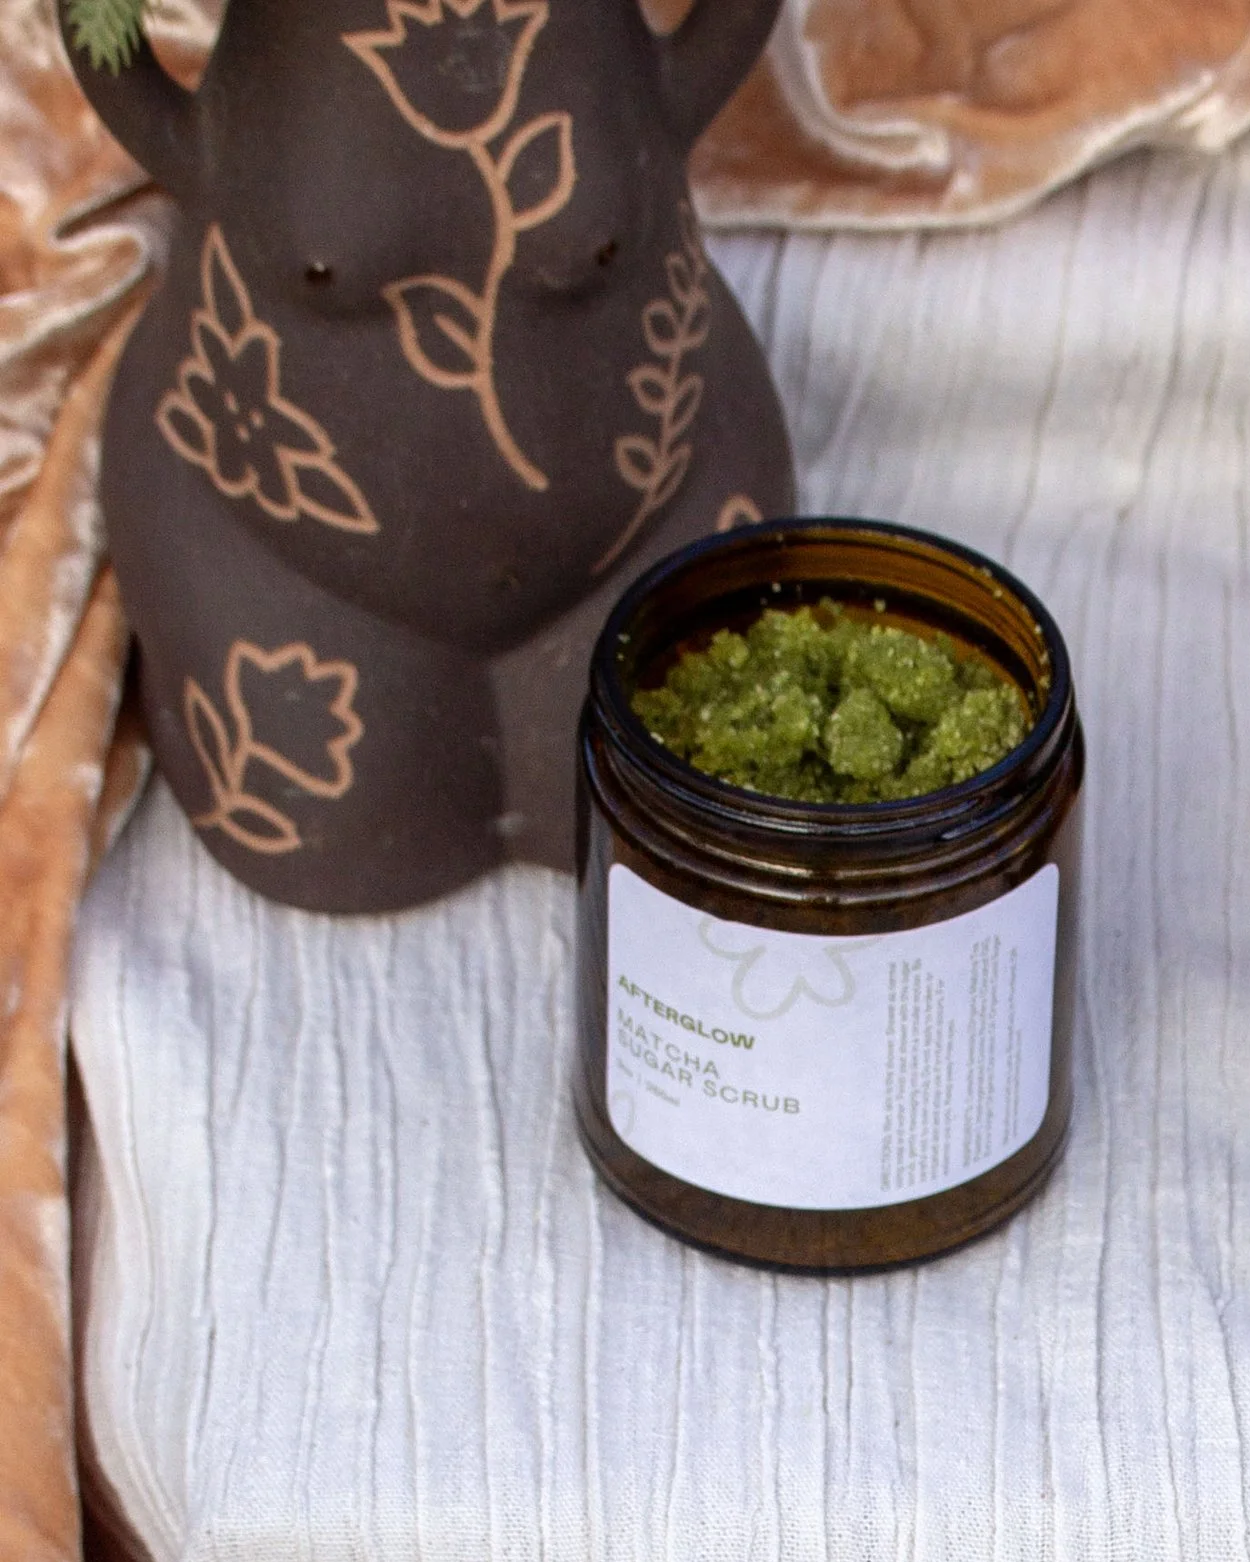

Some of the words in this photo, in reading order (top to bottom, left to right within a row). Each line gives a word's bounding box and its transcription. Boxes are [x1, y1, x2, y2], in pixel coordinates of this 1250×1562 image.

[616, 1007, 720, 1080] MATCHA
[617, 974, 755, 1050] AFTERGLOW
[617, 1032, 693, 1088] SUGAR
[703, 1079, 801, 1115] SCRUB
